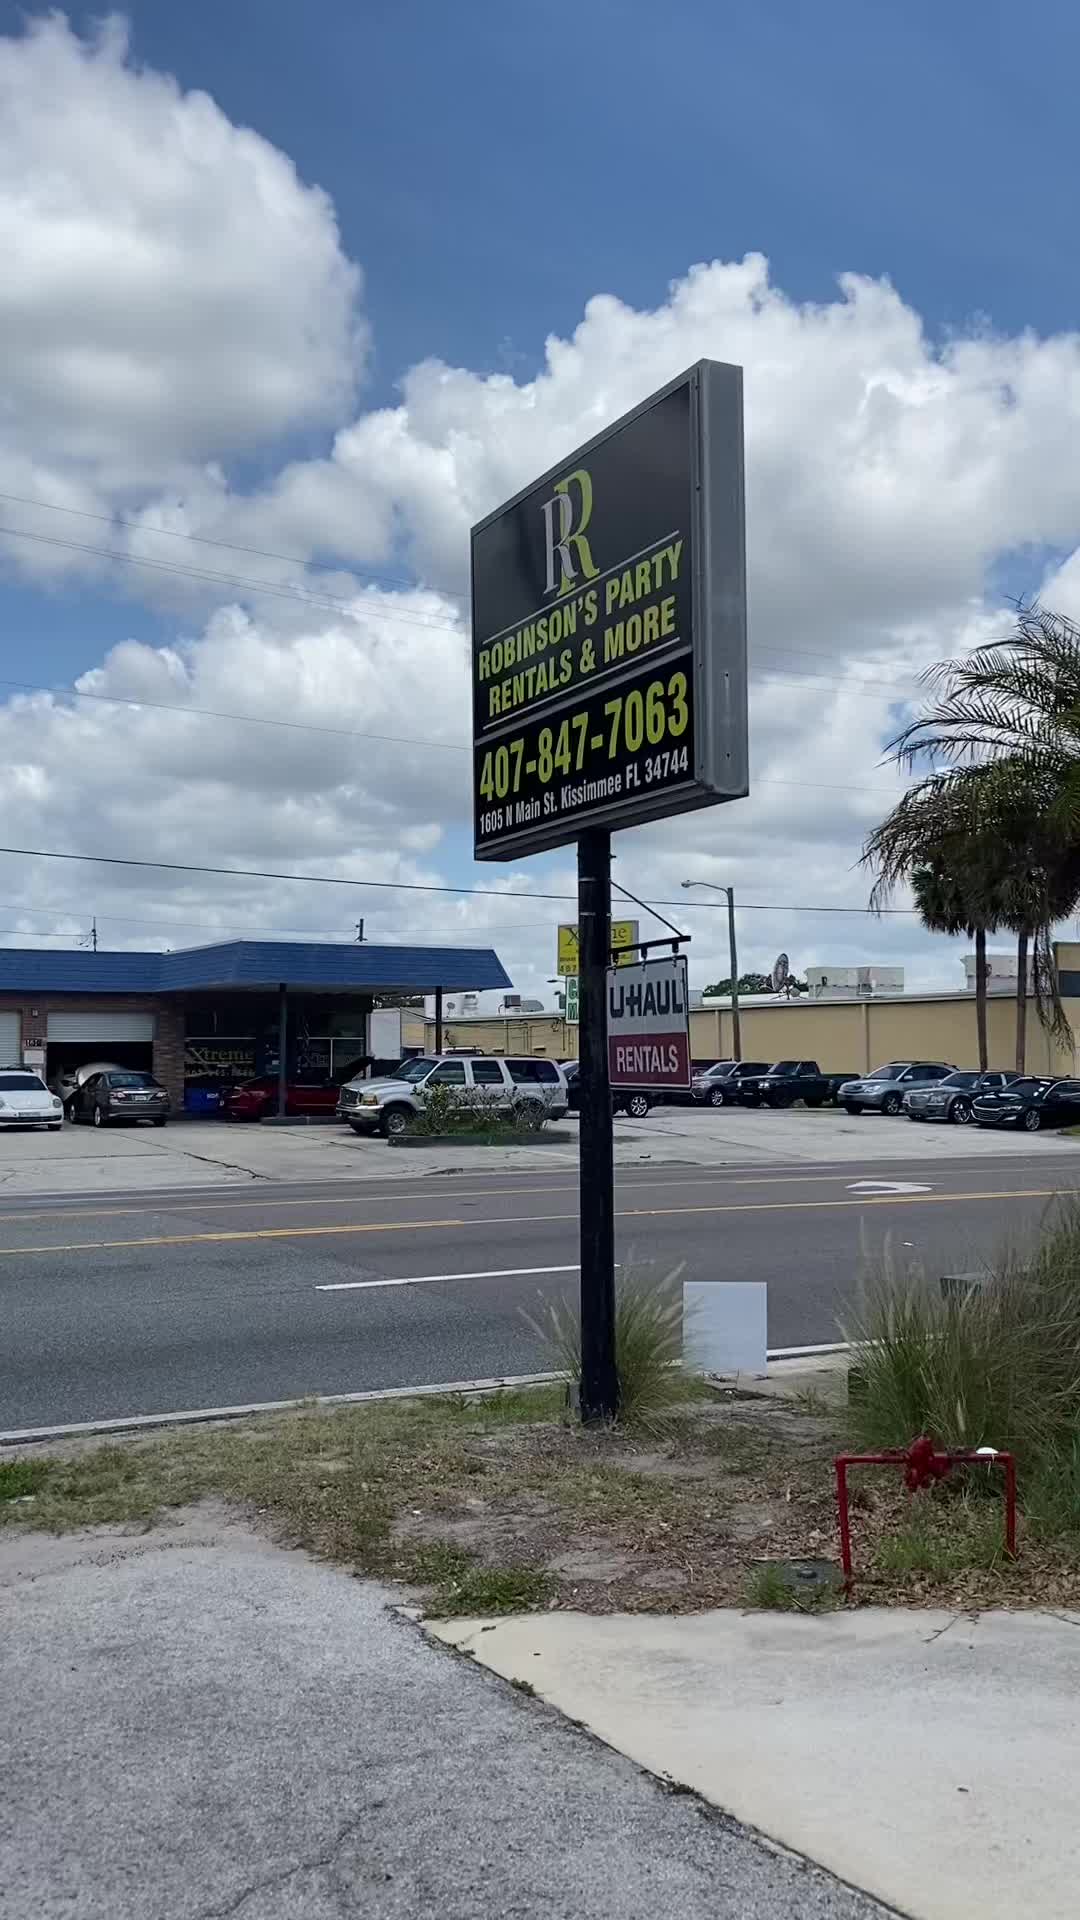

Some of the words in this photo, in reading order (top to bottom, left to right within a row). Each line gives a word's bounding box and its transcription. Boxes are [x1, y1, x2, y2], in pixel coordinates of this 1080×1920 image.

[479, 590, 598, 681] ROBINSON'S
[605, 540, 683, 615] PARTY
[489, 656, 572, 716] RENTALS
[579, 639, 595, 673] &
[604, 596, 675, 663] MORE
[480, 672, 688, 801] 407-847-7063
[480, 808, 503, 834] 1605
[505, 803, 513, 828] N
[515, 796, 541, 824] Main
[543, 791, 558, 816] St.
[561, 774, 622, 808] Kissimmee
[626, 762, 641, 789] FL
[645, 746, 688, 783] 34744
[616, 1045, 678, 1072] RENTALS
